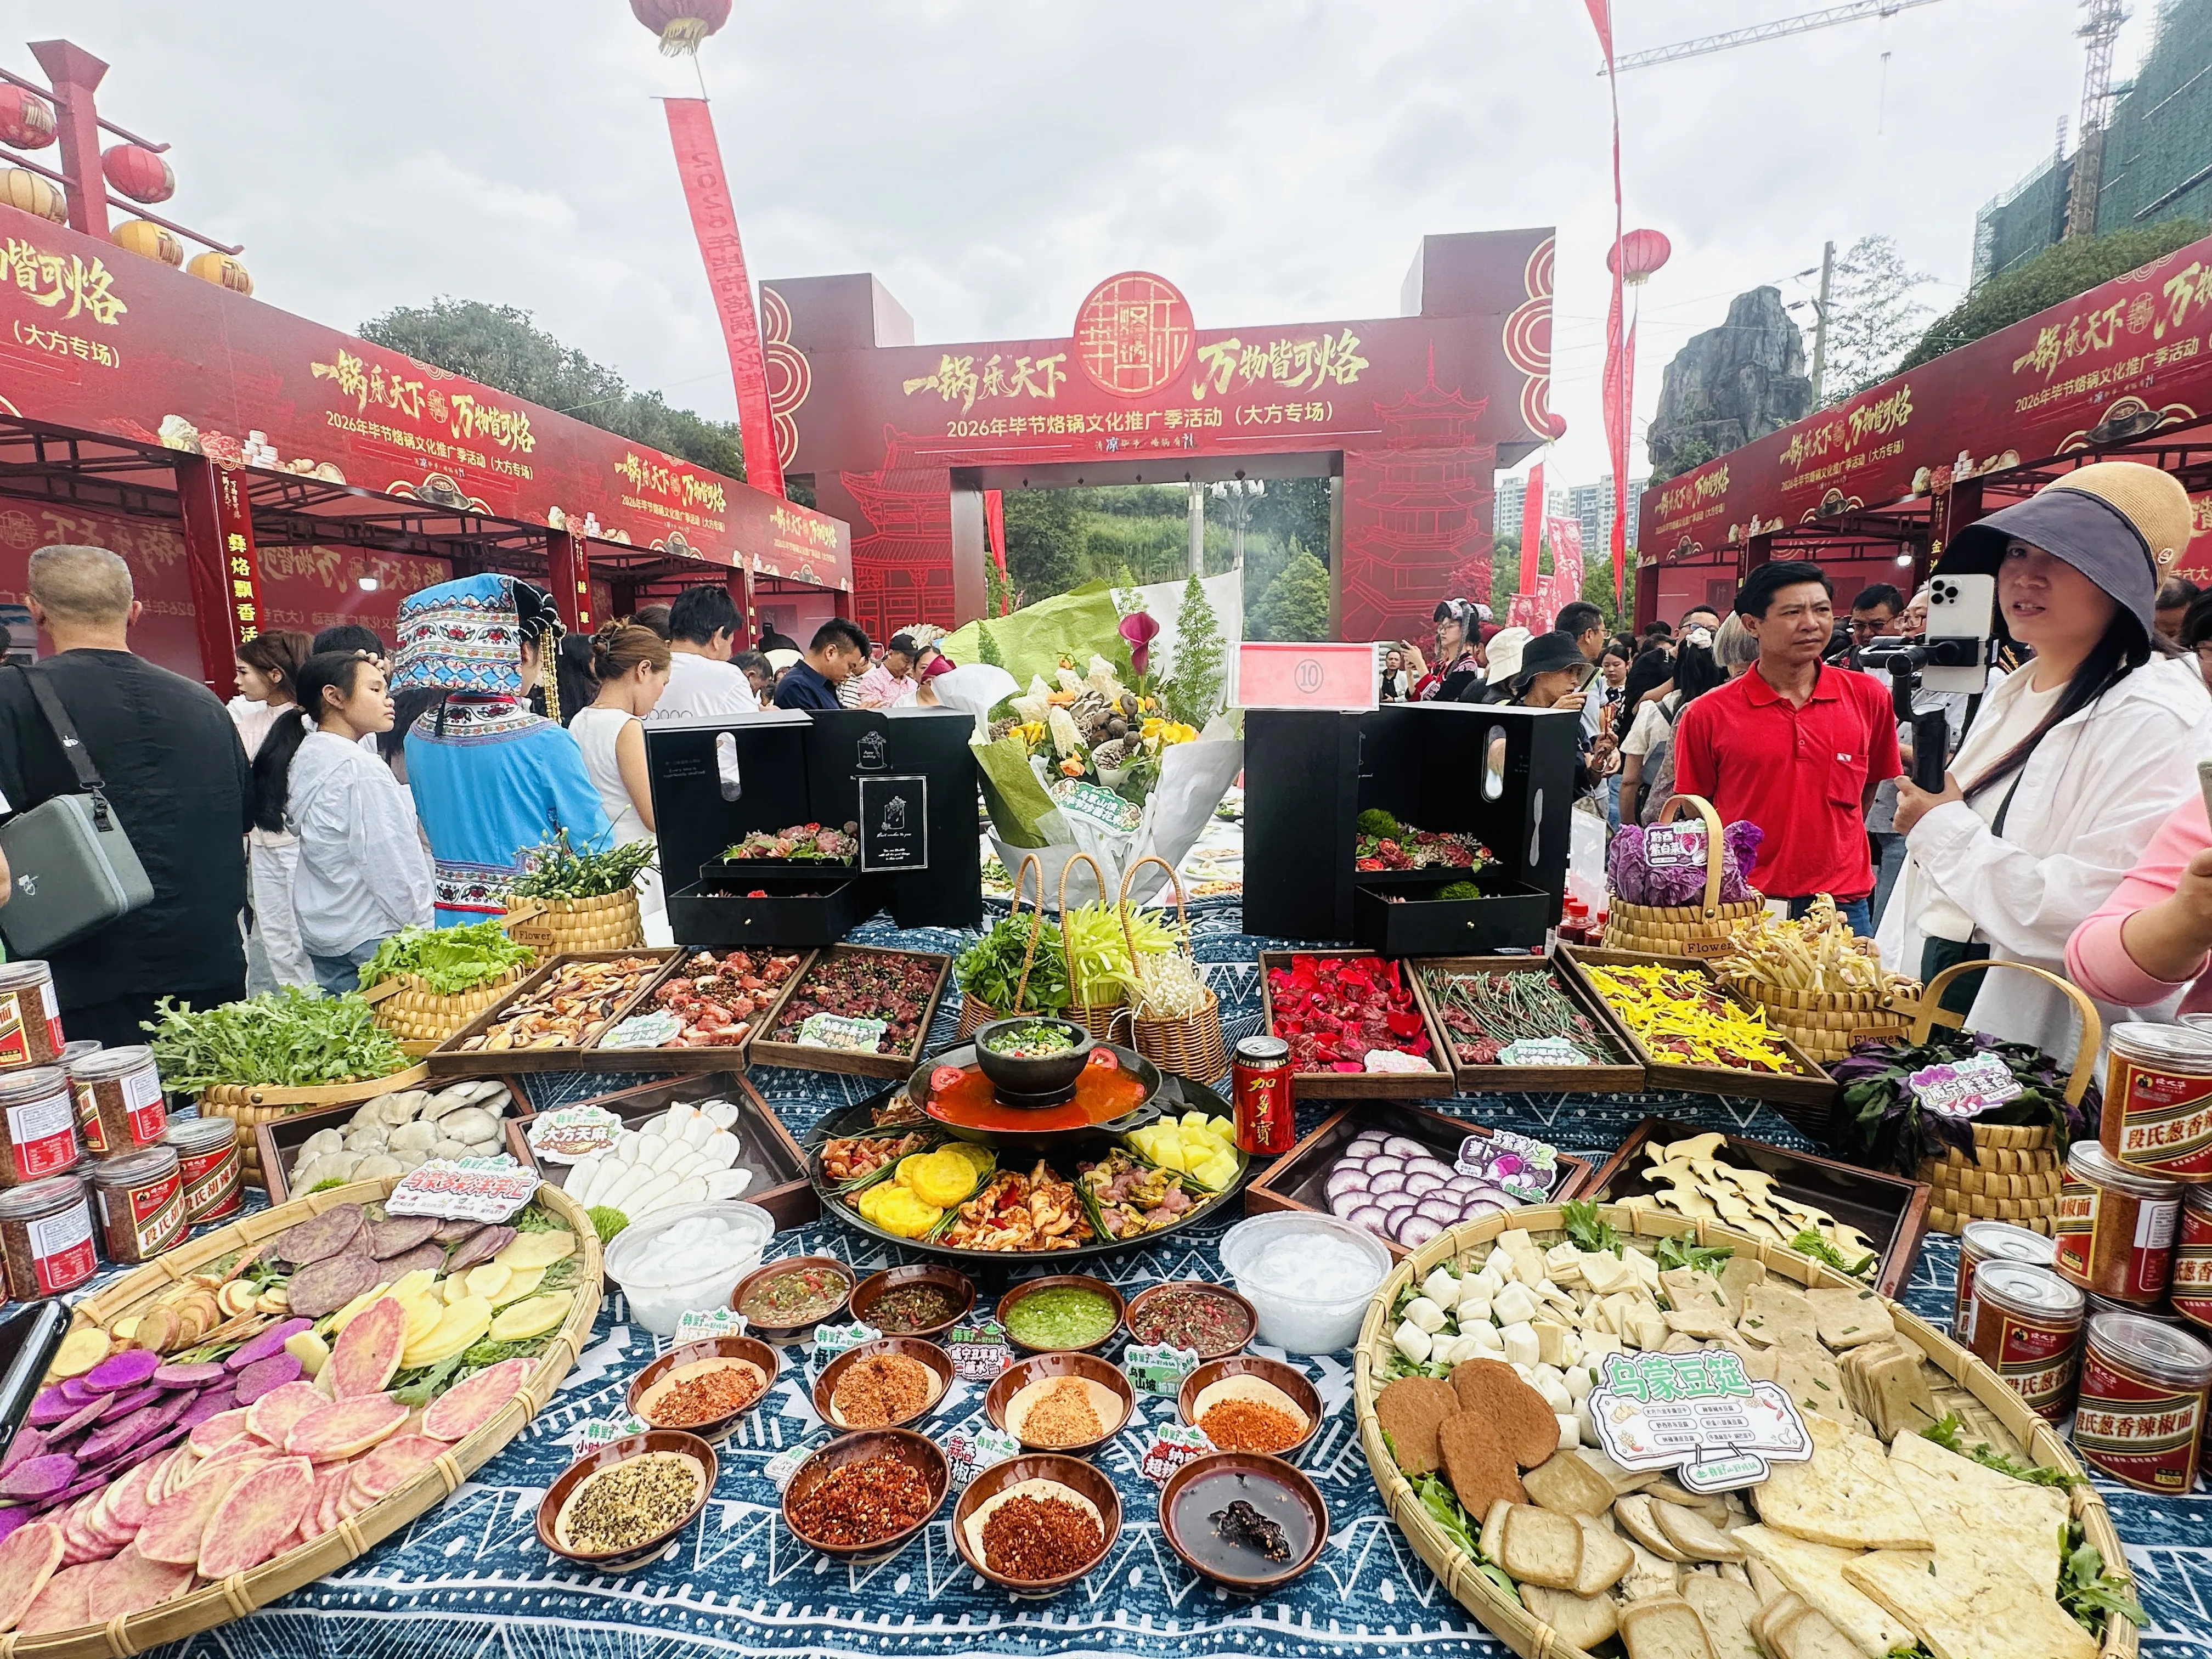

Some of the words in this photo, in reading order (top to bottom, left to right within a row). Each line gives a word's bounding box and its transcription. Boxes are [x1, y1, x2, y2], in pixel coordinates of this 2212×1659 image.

[0, 236, 127, 325] 皆可烙
[1190, 328, 1369, 401] 万物皆可烙
[450, 394, 536, 454] 万物皆可烙
[1844, 383, 1913, 452] 万物皆可烙
[519, 930, 550, 941] Flower
[1687, 940, 1734, 953] Flower
[543, 1127, 608, 1142] 大方天麻
[1466, 1140, 1494, 1160] 萝卜
[404, 1169, 533, 1199] 乌蒙多彩洋芋汇
[1135, 1379, 1156, 1391] 山坡
[1159, 1382, 1179, 1394] 折耳
[1611, 1357, 1751, 1400] 乌蒙豆筵
[2076, 1408, 2193, 1438] 段氏葱香辣椒面
